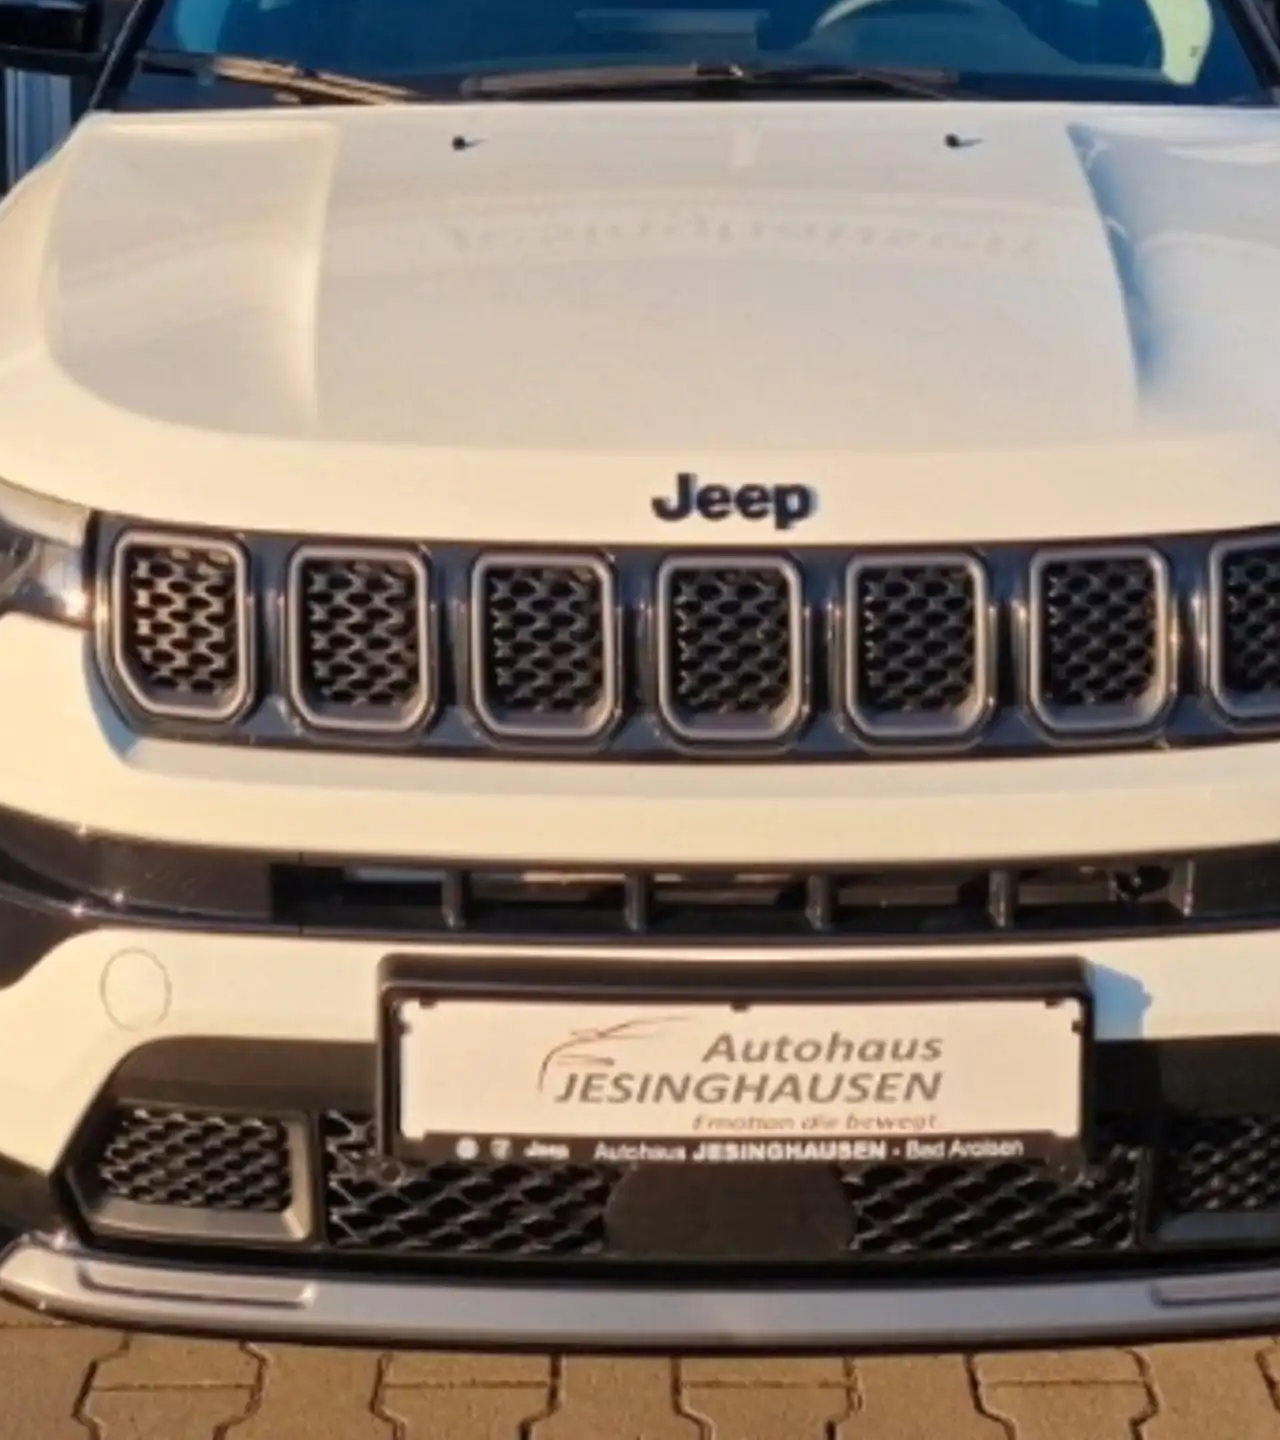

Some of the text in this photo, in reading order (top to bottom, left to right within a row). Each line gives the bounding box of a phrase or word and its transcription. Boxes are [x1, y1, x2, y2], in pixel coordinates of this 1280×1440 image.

[651, 472, 817, 530] Jeep
[701, 1032, 943, 1063] Autohaus
[554, 1071, 943, 1105] JESINGHAUSEN
[593, 1138, 686, 1161] Autohaus
[692, 1140, 886, 1162] JESINGHAUSEN
